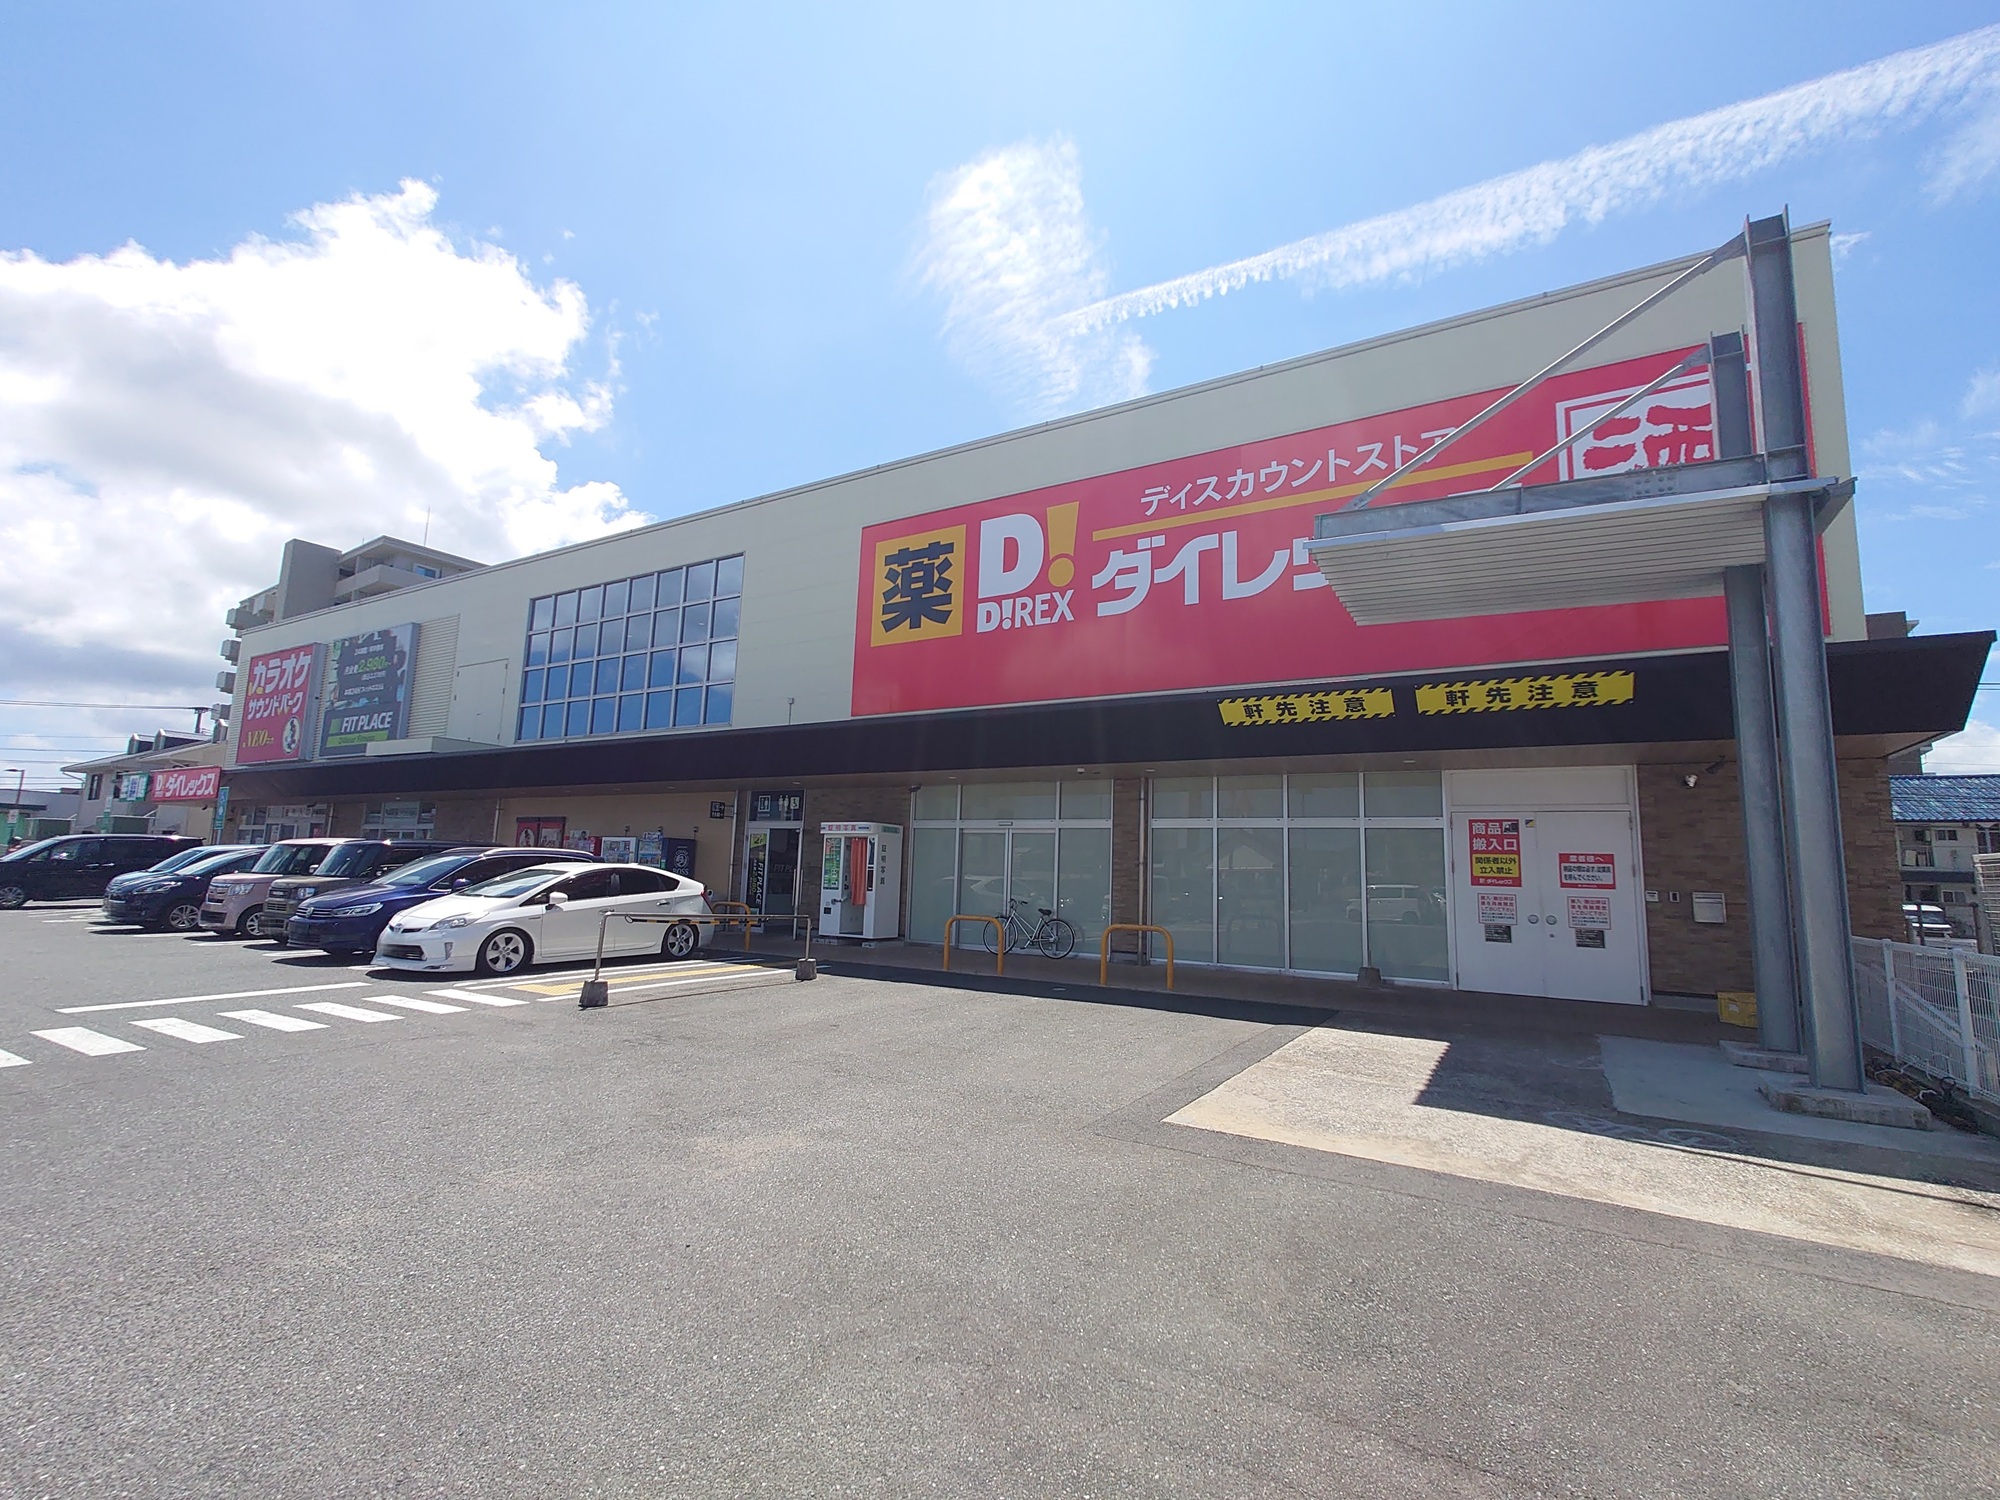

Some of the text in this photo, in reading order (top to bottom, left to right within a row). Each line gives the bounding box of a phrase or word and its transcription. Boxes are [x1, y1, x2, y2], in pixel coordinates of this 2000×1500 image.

[1141, 427, 1458, 517] ディスカウントストア
[881, 541, 955, 633] 薬
[251, 652, 312, 695] カラオケ
[1445, 680, 1600, 708] 軒先注意
[1243, 696, 1368, 720] 軒先注意
[341, 711, 394, 733] FIT PLACE
[165, 773, 216, 797] ダイレックス
[1472, 822, 1502, 835] 商品
[1472, 837, 1518, 851] 搬入口
[1475, 856, 1517, 865] 関係者以外
[1480, 866, 1513, 875] 立入禁止
[755, 875, 763, 905] PLACE
